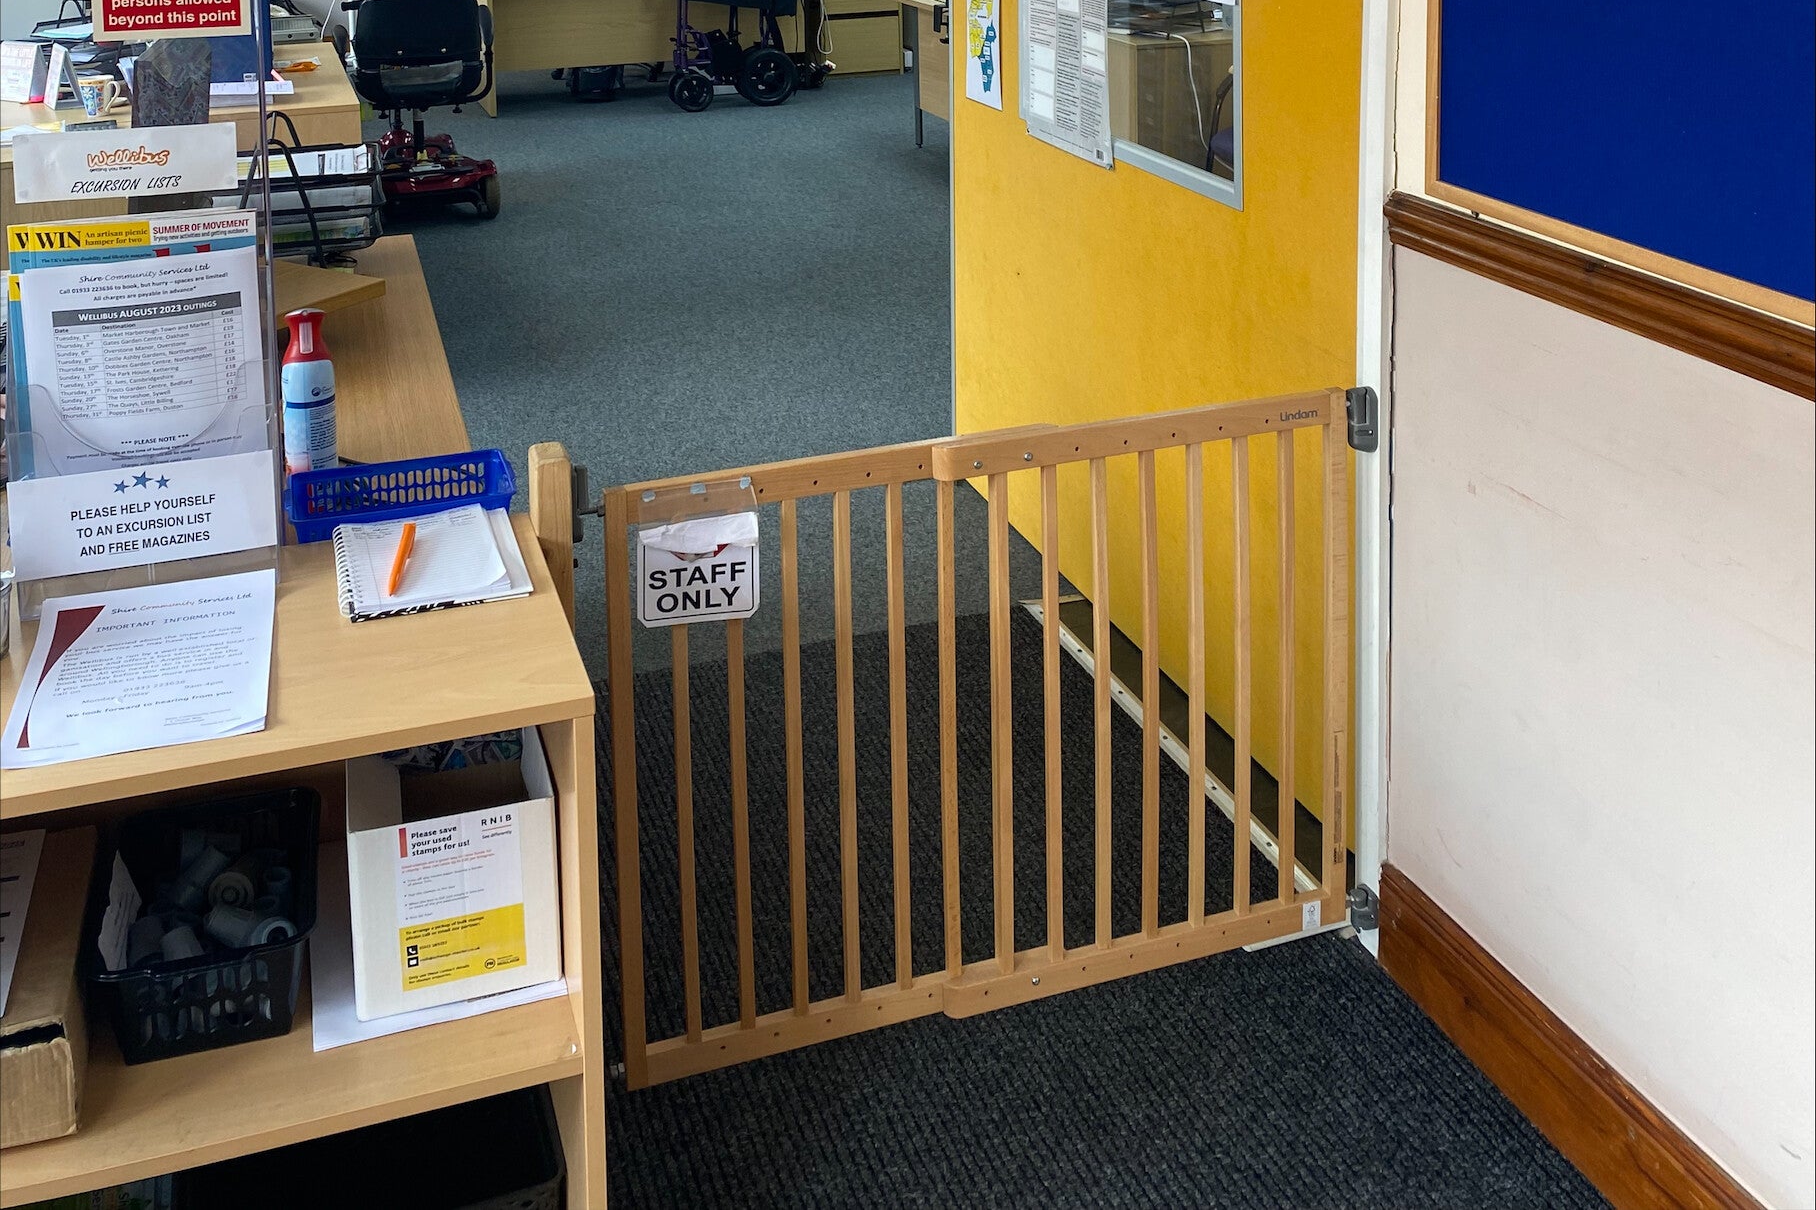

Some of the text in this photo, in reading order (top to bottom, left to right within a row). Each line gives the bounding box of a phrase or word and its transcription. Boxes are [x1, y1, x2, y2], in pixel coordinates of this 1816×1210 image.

[109, 10, 236, 28] beyond this point
[87, 146, 170, 167] Wellibus
[71, 175, 181, 194] EXCURSION LISTS
[125, 228, 148, 237] picnic
[153, 219, 249, 235] SUMMER OF MOVEMENT
[36, 231, 81, 249] WIN
[154, 235, 168, 243] Trying
[210, 229, 226, 237] getting
[105, 272, 157, 281] Community
[159, 268, 192, 276] Services
[195, 263, 210, 272] Ltd
[103, 293, 125, 301] charges
[138, 290, 161, 299] payable
[120, 308, 157, 318] AUGUST
[159, 304, 181, 315] 2023
[102, 322, 136, 330] Destination
[1280, 409, 1318, 421] Lindam
[71, 494, 216, 521] PLEASE HELP YOURSELF
[76, 512, 212, 538] TO AN EXCURSION LIST
[80, 531, 210, 557] AND FREE MAGAZINES
[649, 561, 746, 589] STAFF
[140, 601, 195, 611] Community
[198, 596, 233, 604] Services
[657, 586, 740, 612] ONLY
[96, 611, 236, 632] IMPORTANT INFORMATION
[481, 814, 512, 826] RNIB
[411, 826, 457, 839] Please save
[411, 835, 452, 849] your used
[412, 846, 441, 856] stamps
